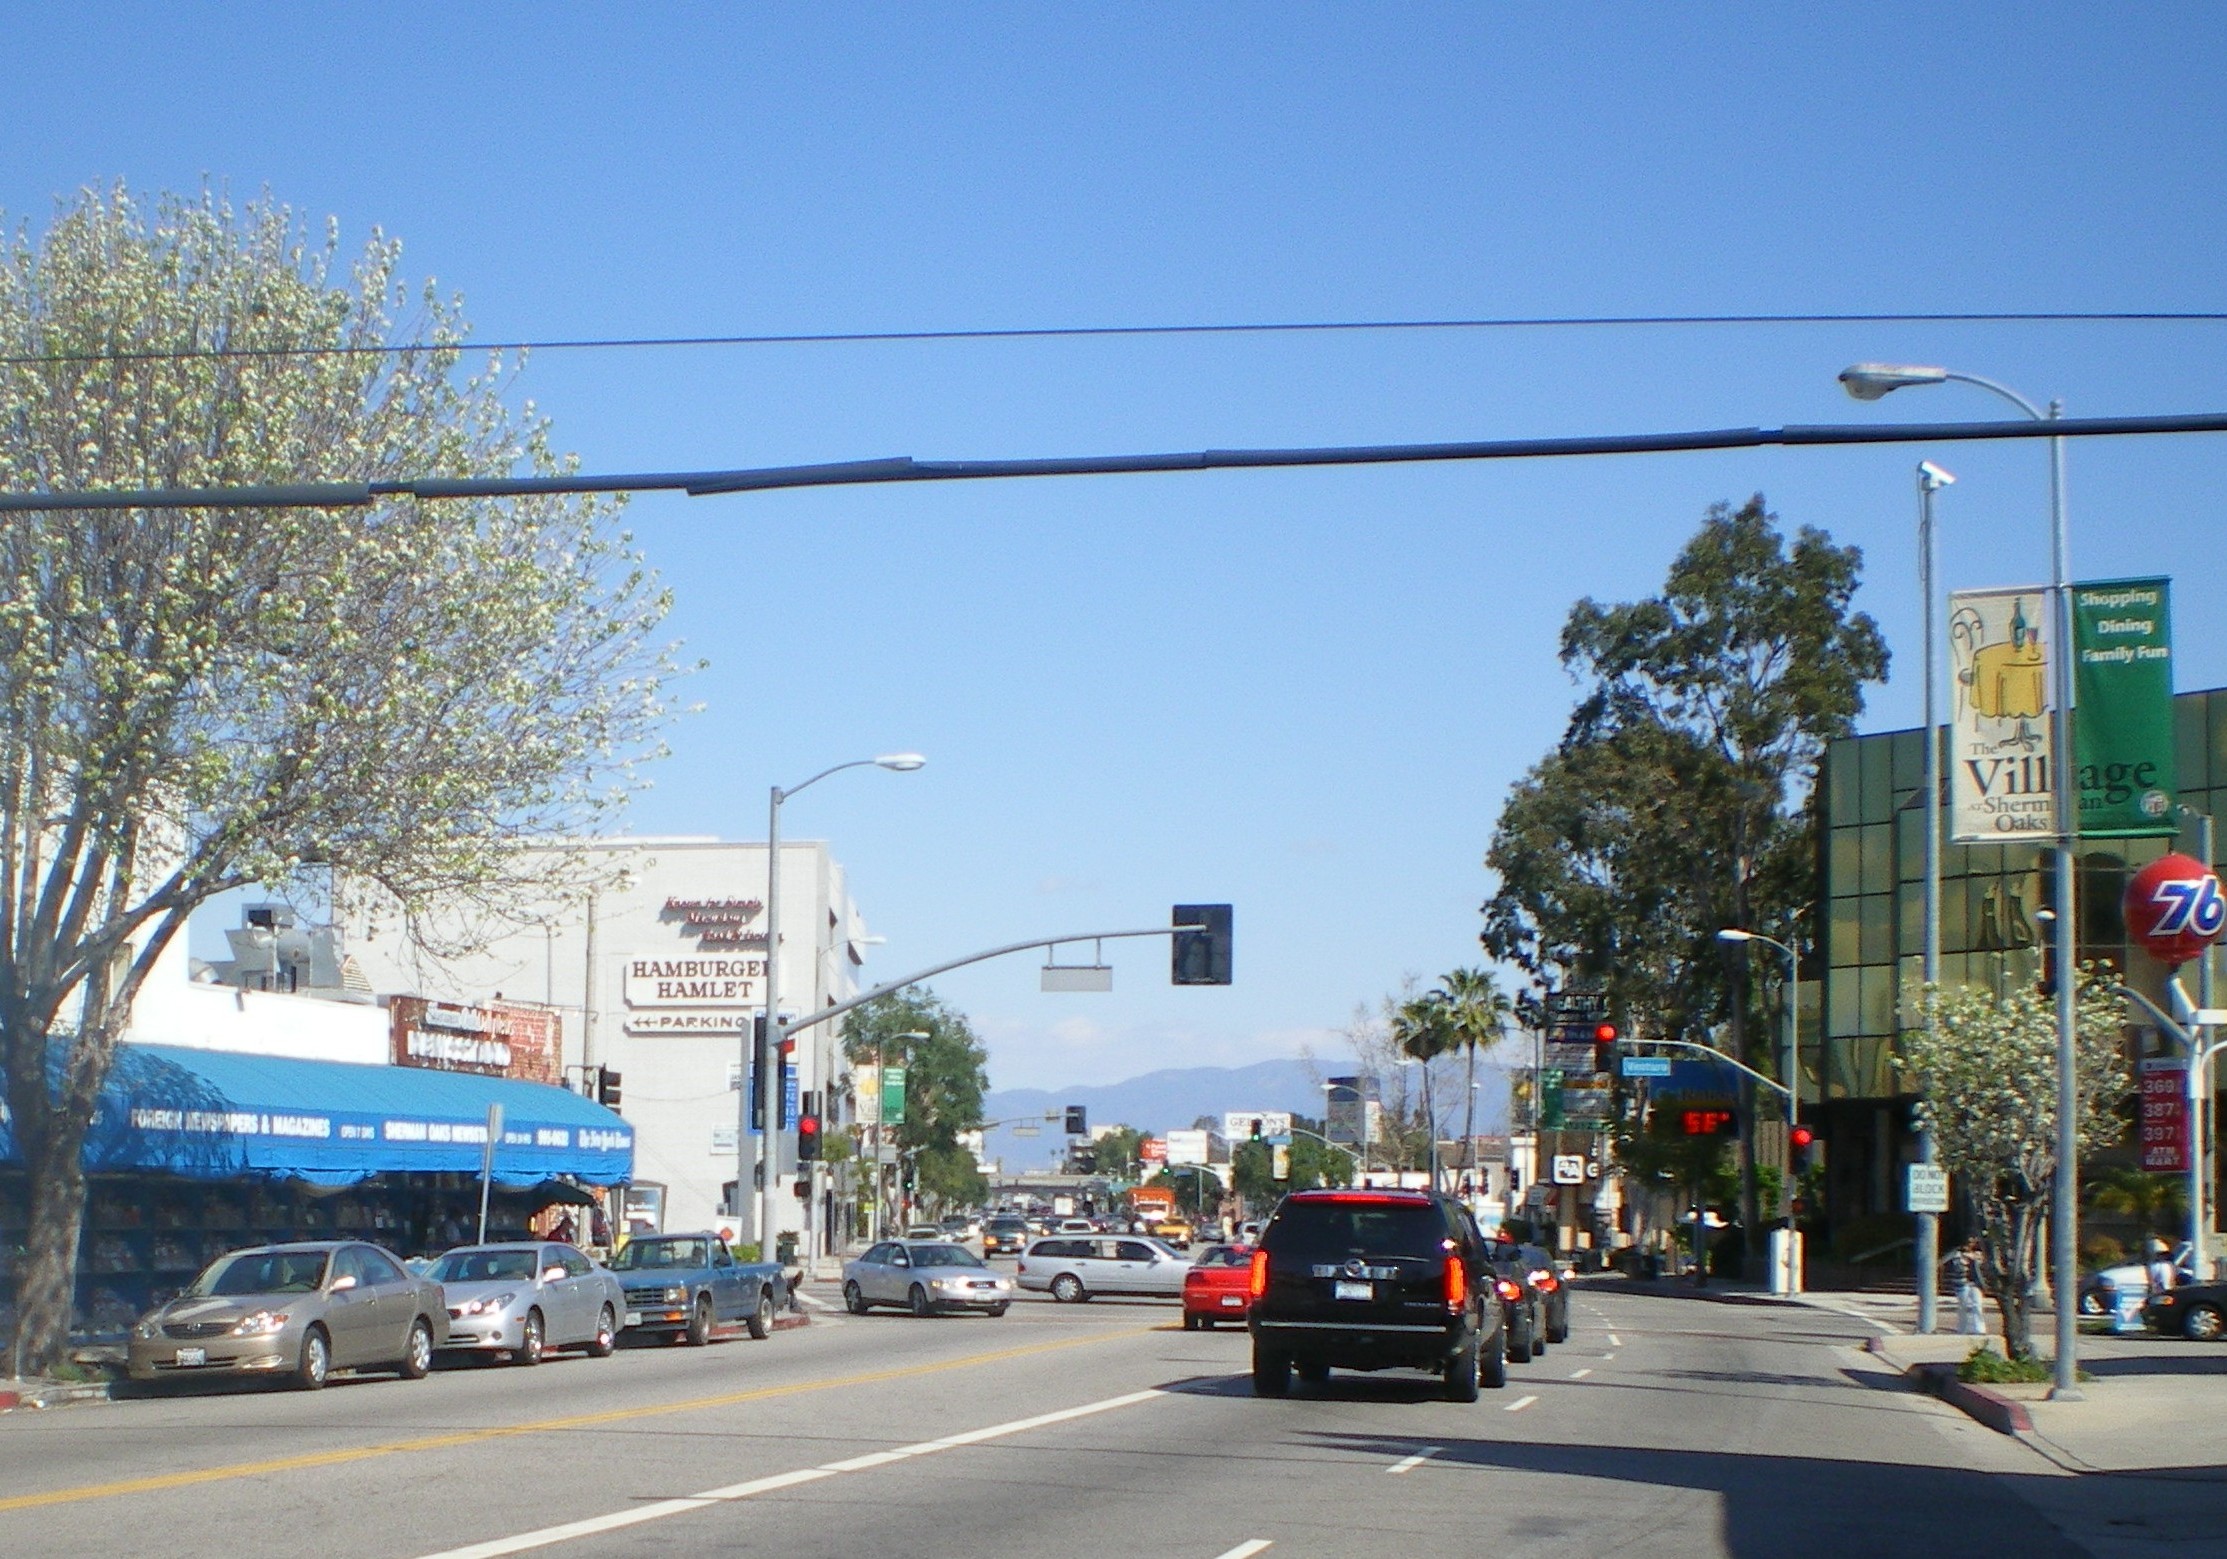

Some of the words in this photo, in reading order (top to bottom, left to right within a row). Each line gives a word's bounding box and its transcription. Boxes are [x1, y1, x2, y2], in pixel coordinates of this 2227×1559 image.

[2080, 589, 2156, 608] Shopping
[2098, 618, 2152, 635] Dining
[2082, 646, 2135, 664] Family
[2137, 645, 2168, 659] Fun
[1971, 743, 1998, 755] The
[1995, 813, 2048, 833] Oaks
[2149, 874, 2226, 936] 76
[657, 981, 753, 998] HAMLET
[130, 1108, 183, 1131] FOREIGN
[185, 1111, 259, 1134] NEWSPAPERS
[260, 1114, 271, 1134] &
[272, 1115, 331, 1139] MAGAZINES
